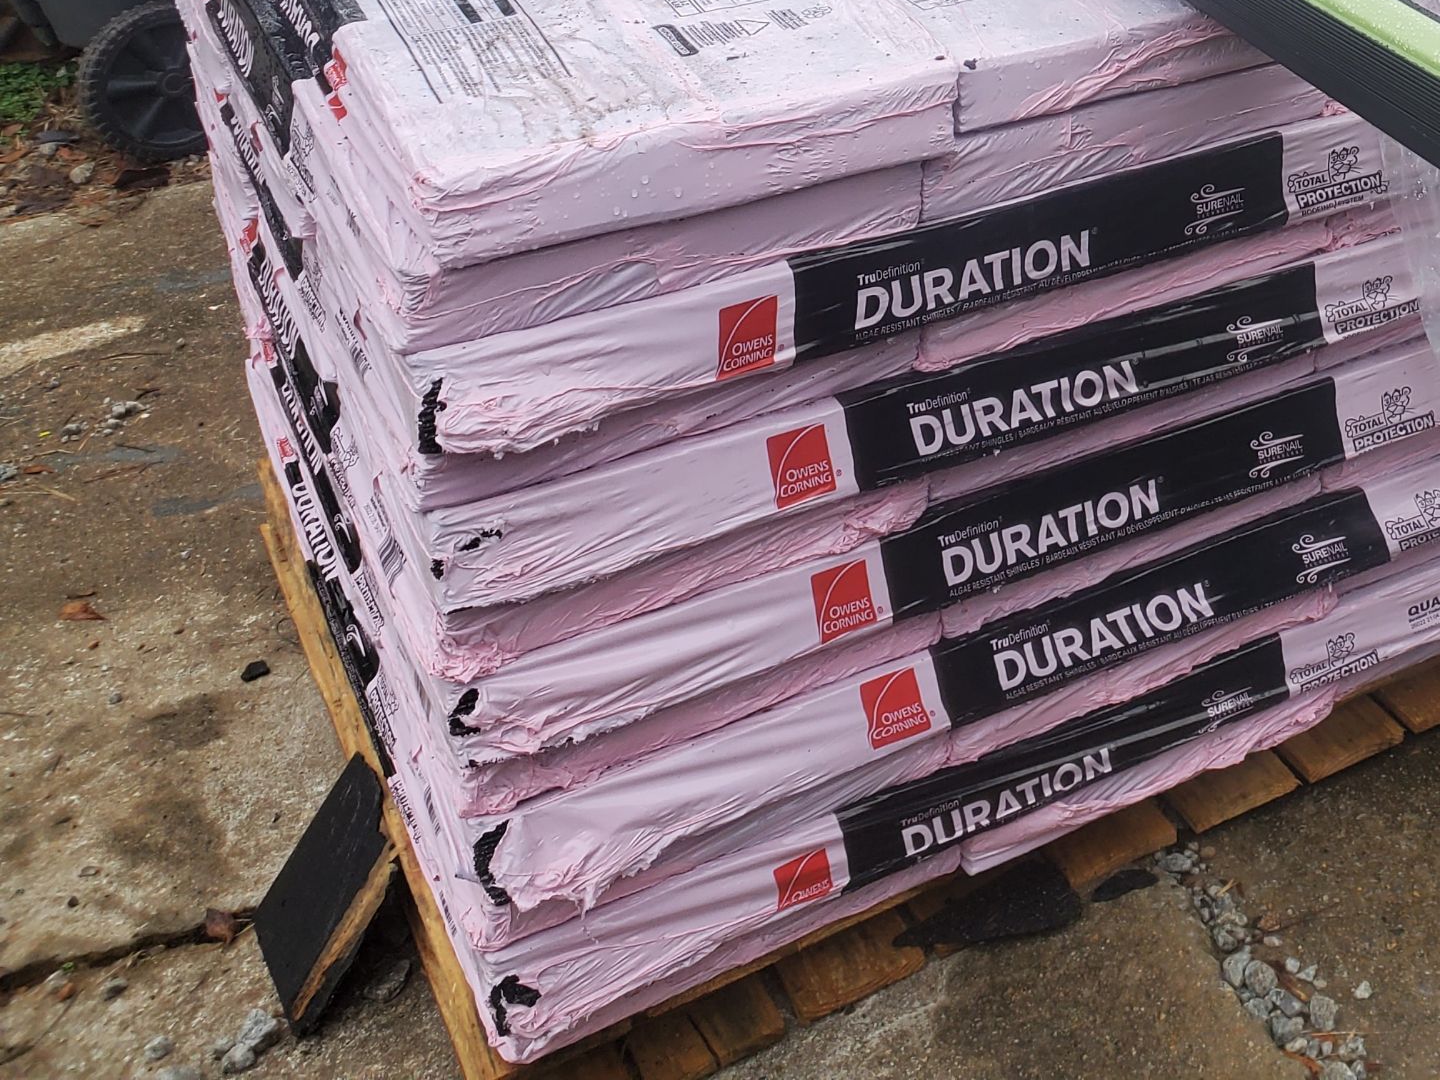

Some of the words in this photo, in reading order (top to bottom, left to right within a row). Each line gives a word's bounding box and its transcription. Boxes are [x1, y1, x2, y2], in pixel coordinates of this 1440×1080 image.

[1295, 173, 1328, 191] TOTAL
[1298, 173, 1382, 208] PROTECTION
[1196, 193, 1244, 215] SURENAIL
[854, 229, 1091, 330] DURATION
[857, 260, 921, 286] TruDefinition
[1333, 303, 1367, 320] TOTAL
[1336, 300, 1419, 335] PROTECTION
[881, 316, 921, 335] RESISTANT
[1237, 325, 1283, 344] SURENAIL
[732, 333, 774, 355] OWENS
[723, 345, 774, 372] CORNING
[907, 390, 968, 415] TruDefinition
[909, 360, 1139, 457] DURATION
[1351, 415, 1385, 432] TOTAL
[1354, 414, 1434, 452] PROTECTION
[1257, 440, 1302, 460] SURENAIL
[780, 471, 832, 498] CORNING
[785, 459, 830, 483] OWENS
[937, 519, 999, 547] TruDefinition
[941, 479, 1160, 587] DURATION
[1394, 519, 1425, 537] TOTAL
[949, 583, 972, 597] ALGAE
[972, 571, 1006, 590] RESISTANT
[1006, 558, 1040, 578] SHINGLES
[1045, 545, 1079, 563] BARDEAUX
[1117, 527, 1126, 537] AU
[1302, 543, 1348, 564] SURENAIL
[822, 607, 873, 634] CORNING
[828, 596, 870, 619] OWENS
[990, 622, 1048, 651] TruDefinition
[993, 583, 1215, 691] DURATION
[1300, 662, 1327, 680] TOTAL
[1301, 652, 1378, 693] PROTECTION
[1006, 687, 1026, 700] ALGAE
[1026, 673, 1064, 695] RESISTANT
[881, 702, 922, 725] OWENS
[1207, 691, 1250, 718] SURENAIL
[872, 713, 927, 740] CORNING
[901, 748, 1113, 859] DURATION
[901, 799, 960, 828] TruDefinition
[791, 877, 830, 901] OWENS
